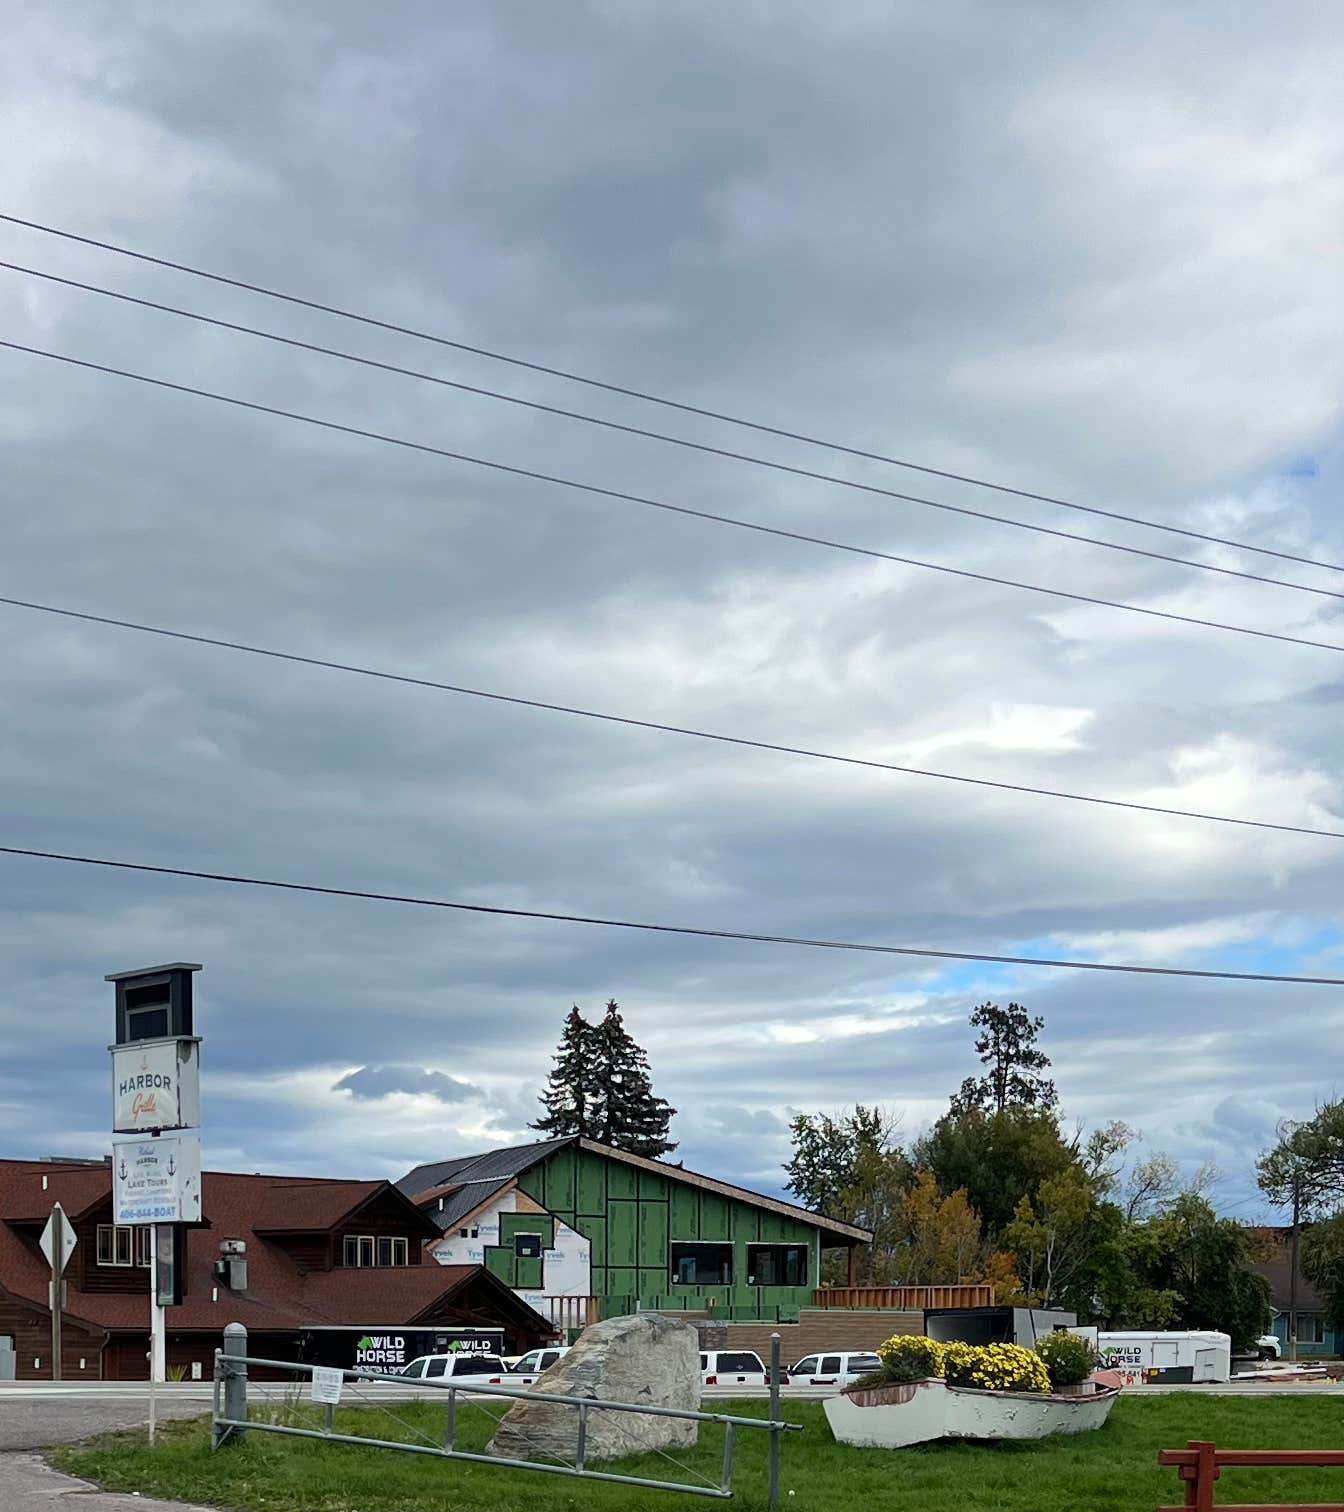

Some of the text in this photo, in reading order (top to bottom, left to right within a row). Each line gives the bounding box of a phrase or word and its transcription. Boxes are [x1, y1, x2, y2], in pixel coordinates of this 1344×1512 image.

[119, 1074, 171, 1097] HARBOR
[369, 1336, 405, 1350] WILD
[459, 1340, 492, 1350] WILD
[356, 1350, 406, 1363] HORSE
[1114, 1347, 1142, 1355] WILD
